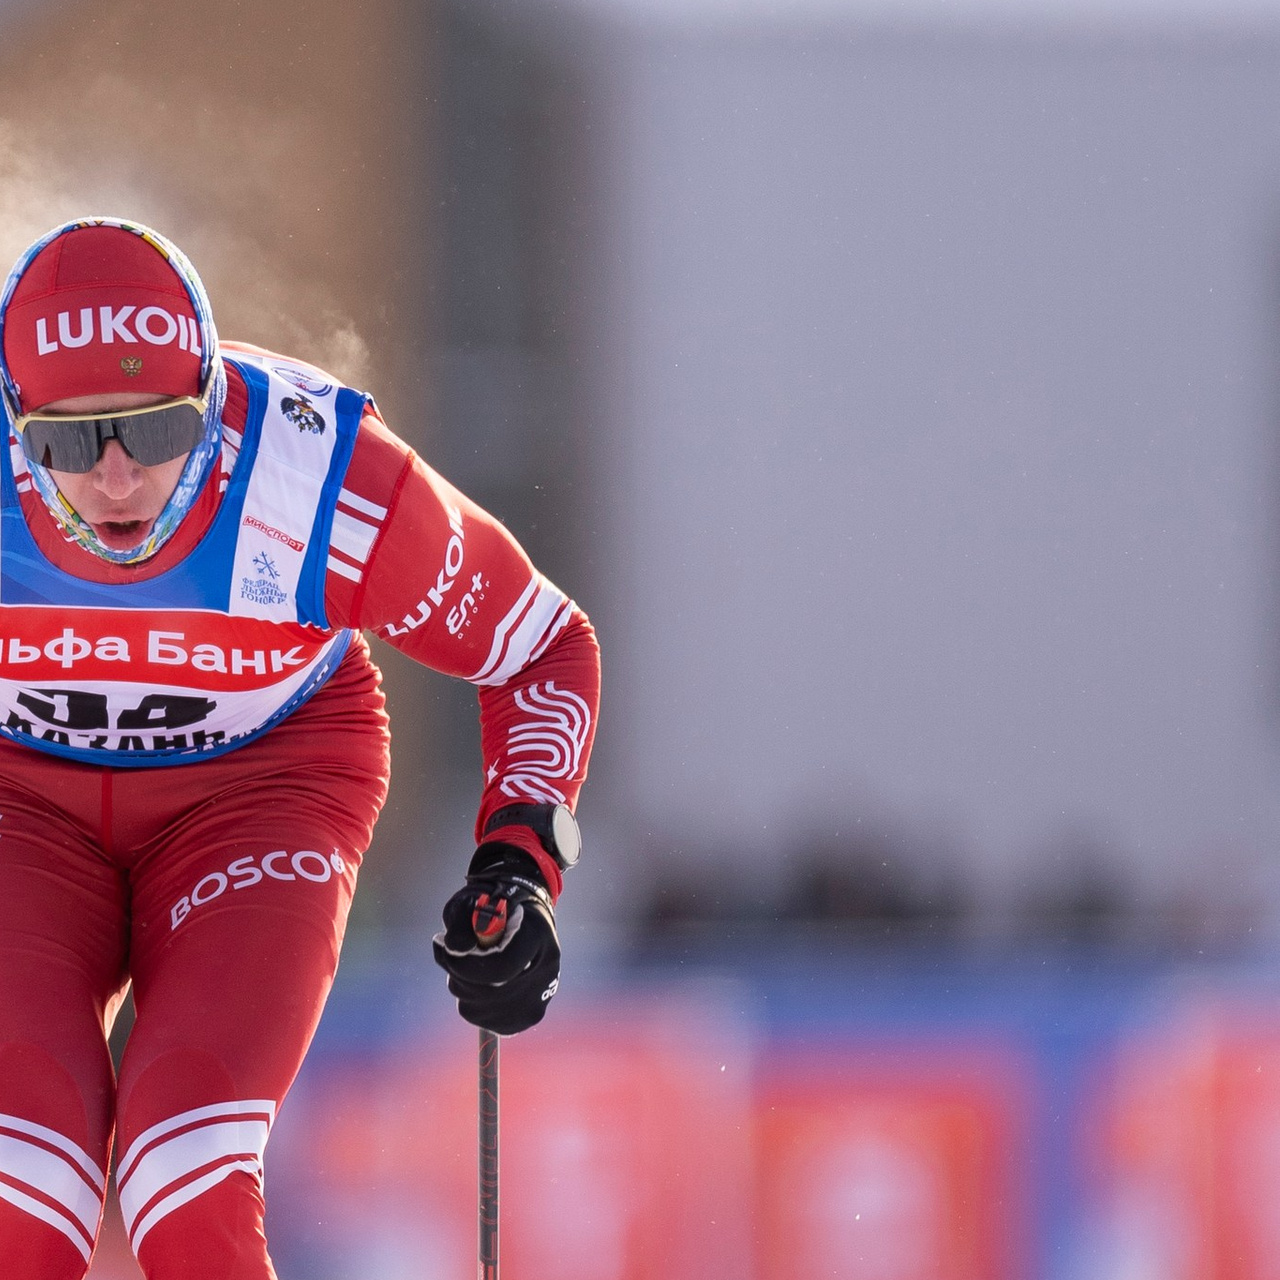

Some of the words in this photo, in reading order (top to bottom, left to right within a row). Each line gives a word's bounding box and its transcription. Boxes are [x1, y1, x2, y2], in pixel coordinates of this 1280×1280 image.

[36, 305, 202, 357] LUKOIL
[244, 517, 304, 551] МИНСПОРТ
[148, 630, 307, 675] Банк
[170, 850, 332, 931] BOSCO
